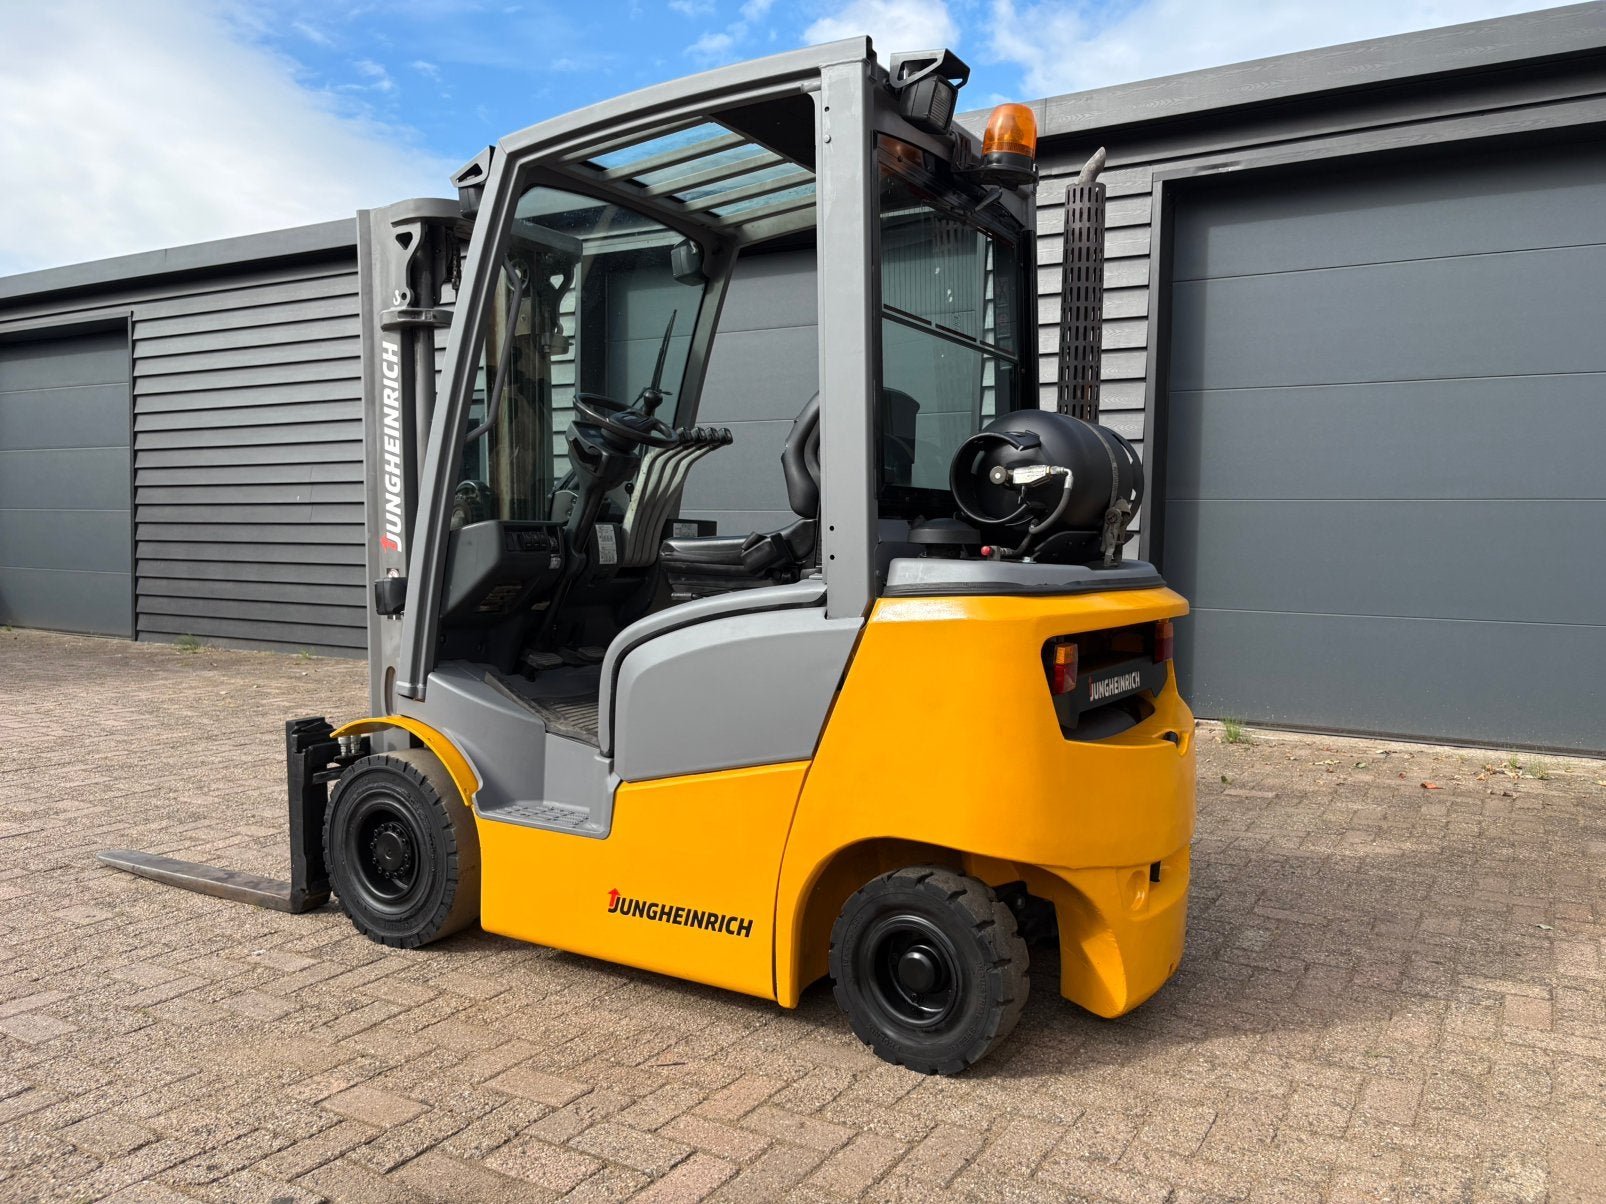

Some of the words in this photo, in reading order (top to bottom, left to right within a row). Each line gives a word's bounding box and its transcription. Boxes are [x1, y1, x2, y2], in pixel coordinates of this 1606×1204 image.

[382, 341, 403, 553] JUNGHEINRICH
[1089, 671, 1140, 702] JUNGHEINRICH
[607, 896, 754, 938] JUNGHEINRICH
